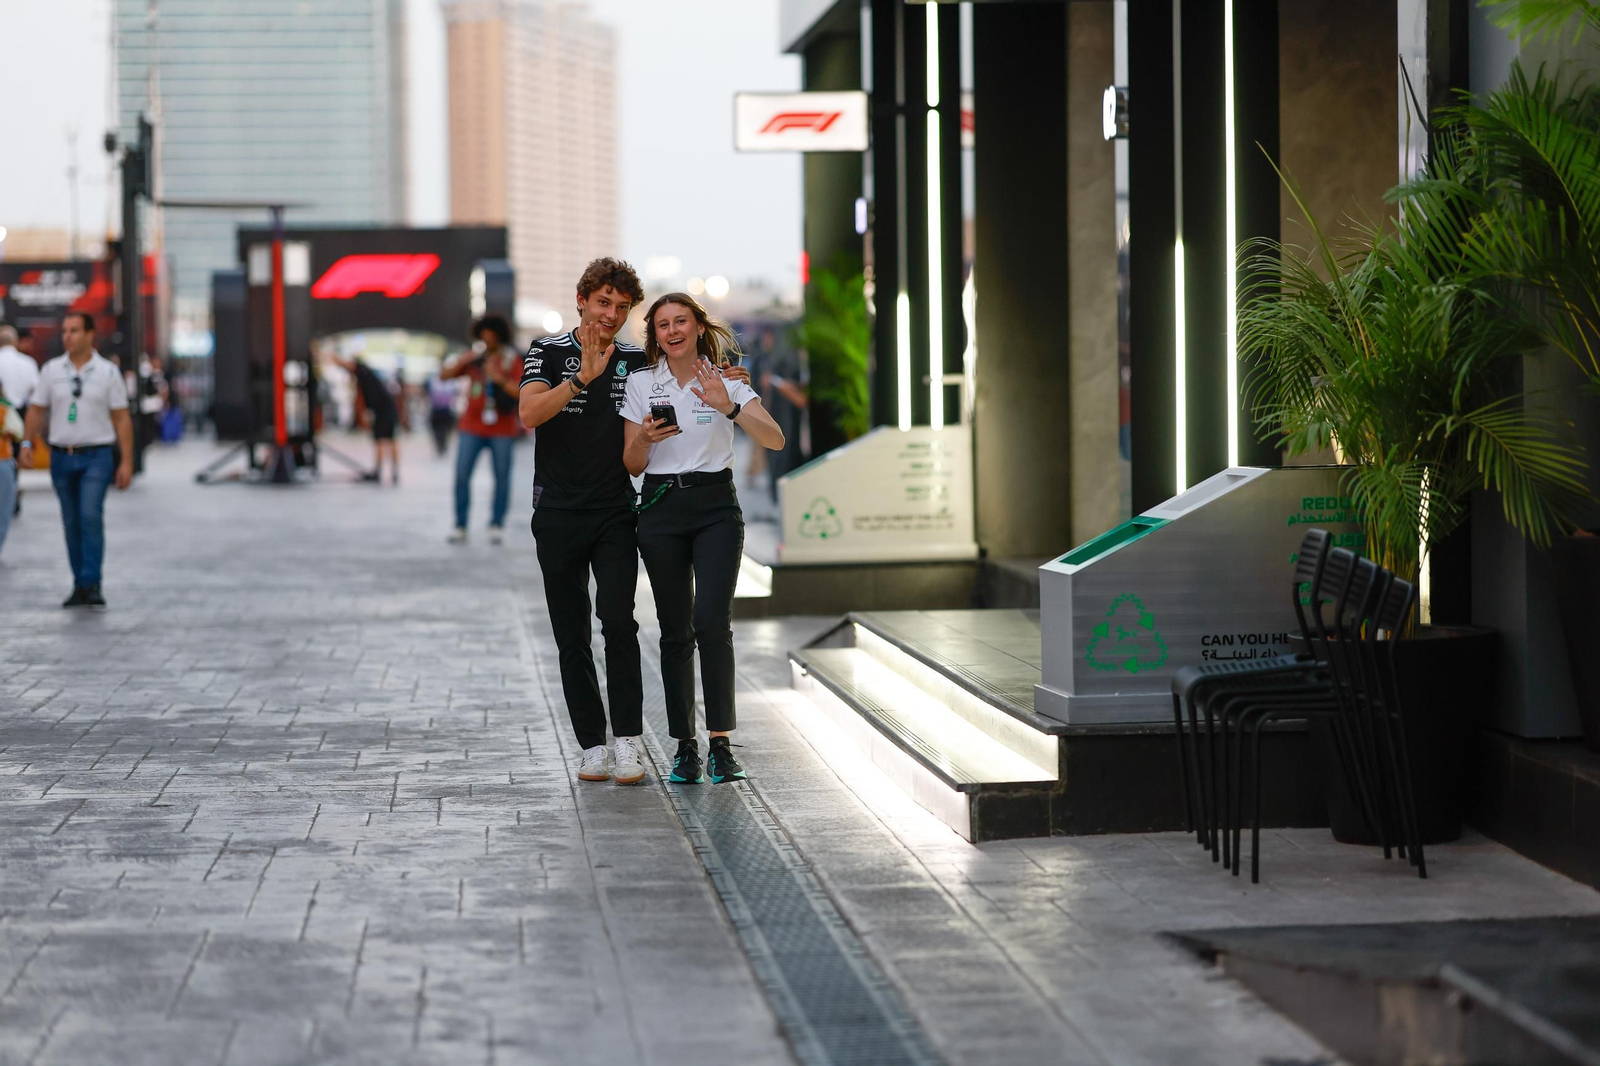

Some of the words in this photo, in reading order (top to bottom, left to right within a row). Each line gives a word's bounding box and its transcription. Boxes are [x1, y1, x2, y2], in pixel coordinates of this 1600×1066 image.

[1302, 496, 1354, 510] REDU
[1330, 533, 1366, 547] USE
[1201, 635, 1234, 646] CAN
[1238, 633, 1268, 645] YOU
[1272, 632, 1289, 644] HE
